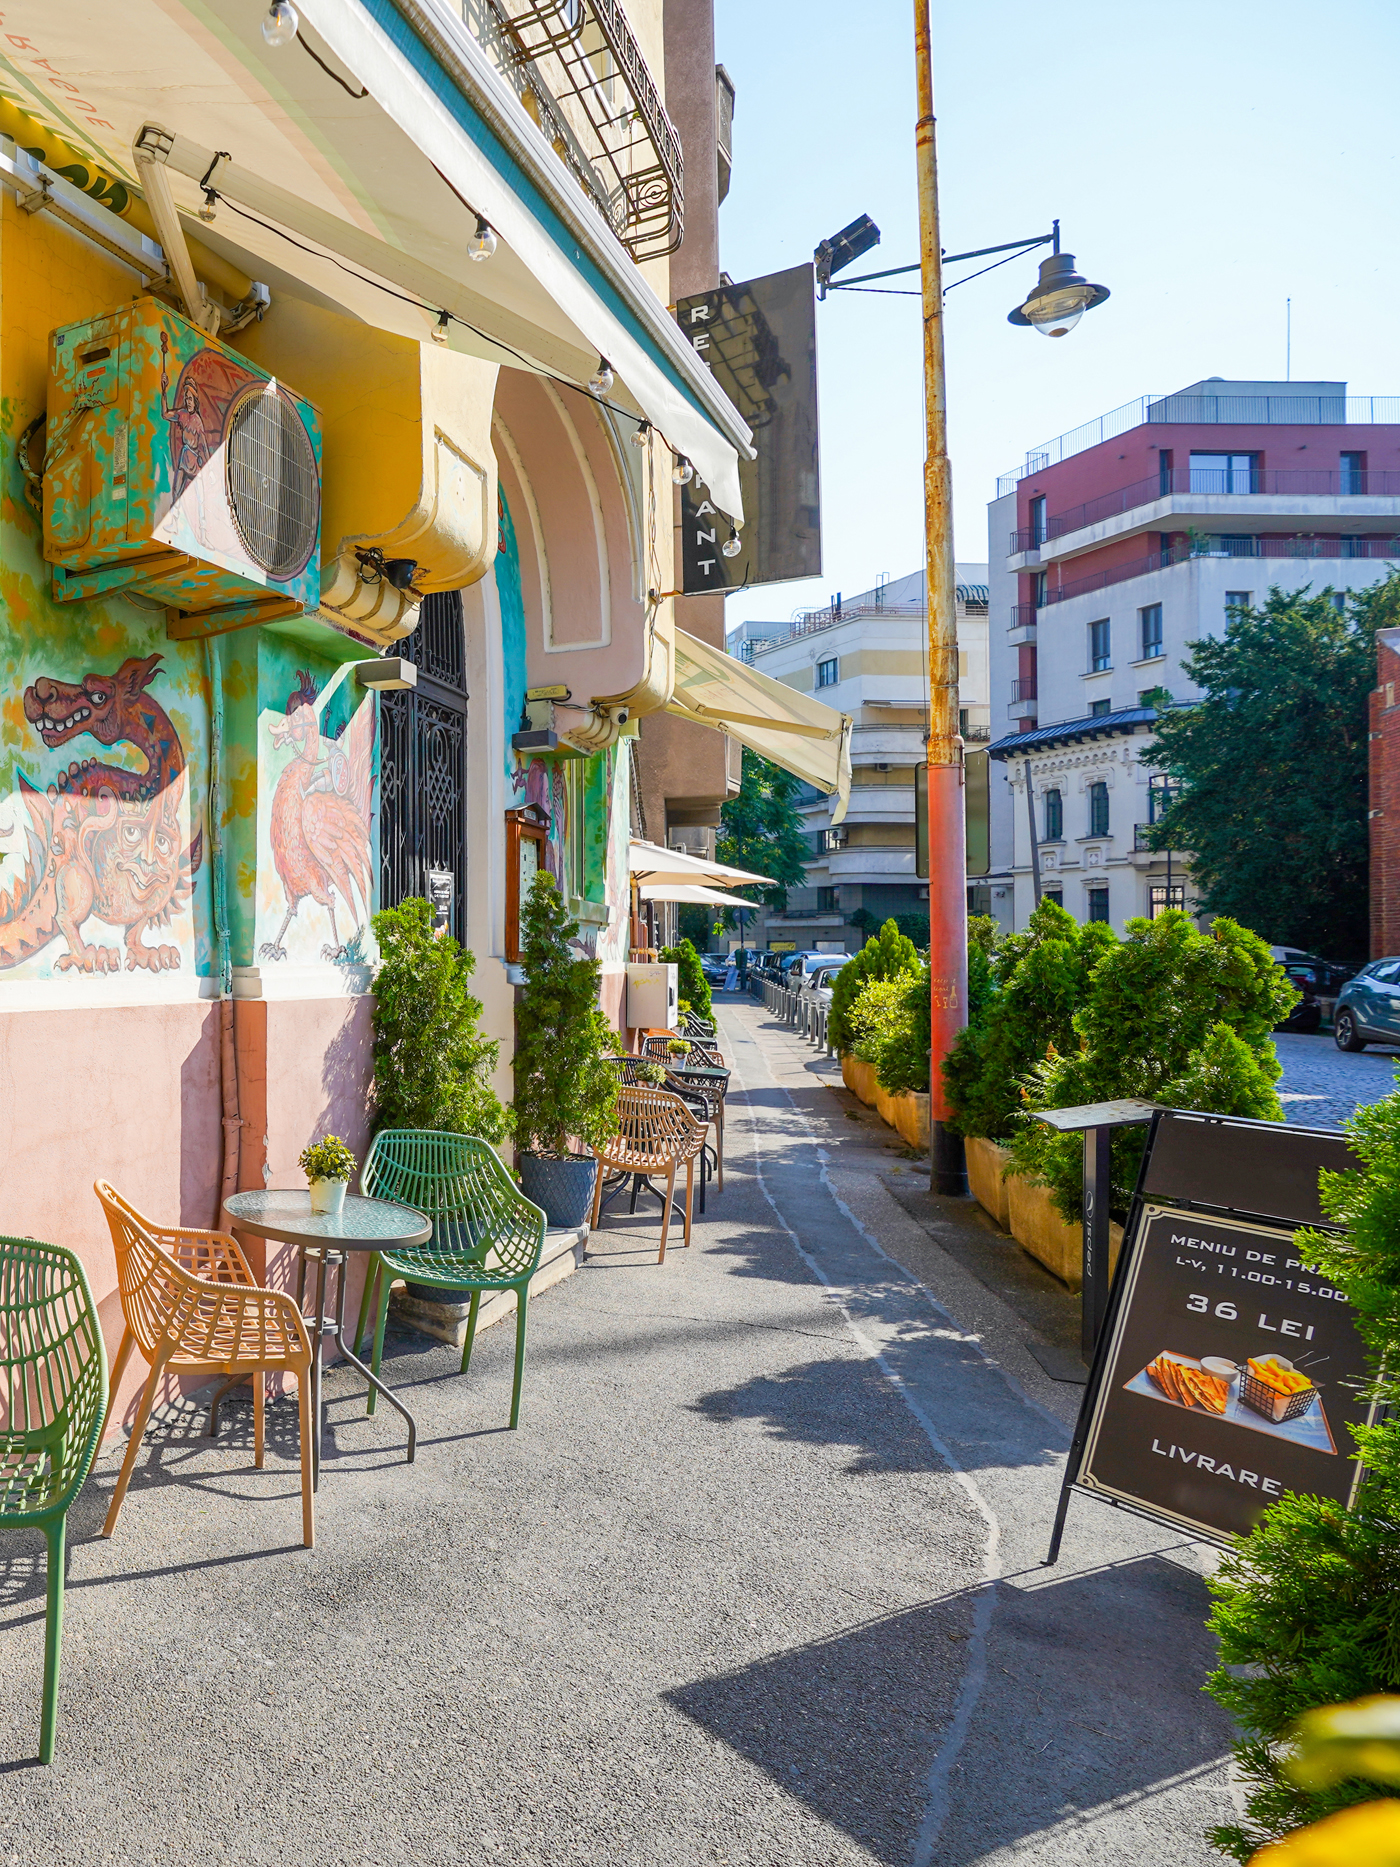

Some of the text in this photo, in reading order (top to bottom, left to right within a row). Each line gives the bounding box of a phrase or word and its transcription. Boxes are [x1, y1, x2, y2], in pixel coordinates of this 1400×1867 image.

[1170, 1234, 1237, 1257] MENIU
[1246, 1250, 1277, 1265] DE
[1175, 1256, 1349, 1302] L-V, 11.00-15.00
[1186, 1294, 1315, 1341] 36 LEI
[1151, 1438, 1282, 1496] LIVRARE
